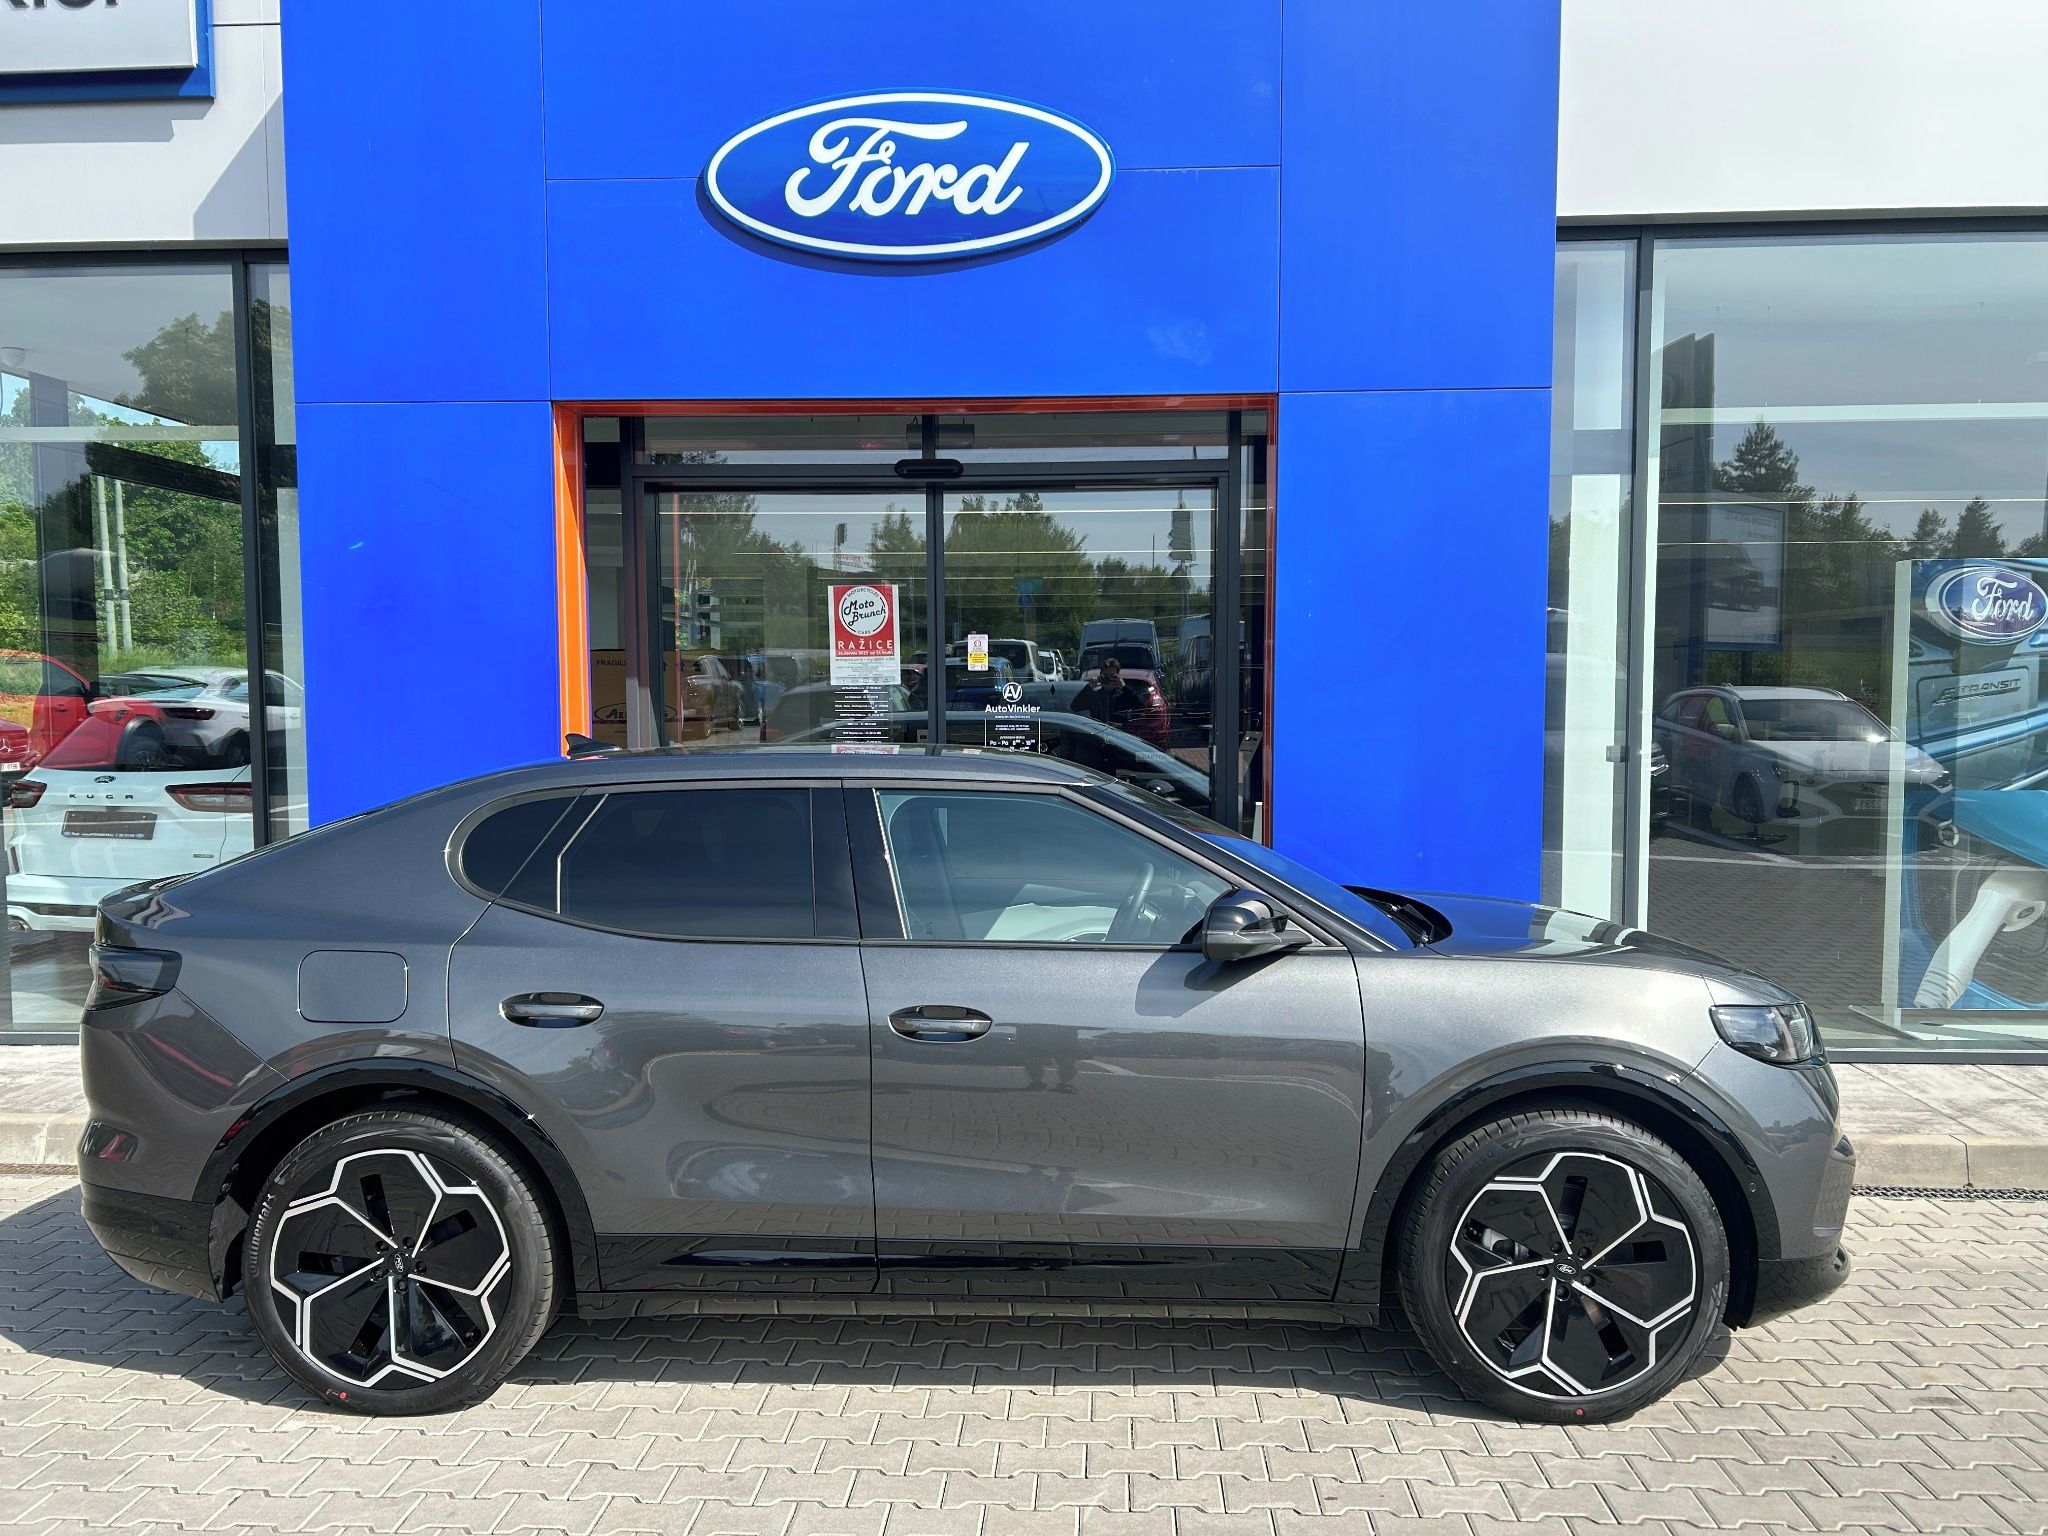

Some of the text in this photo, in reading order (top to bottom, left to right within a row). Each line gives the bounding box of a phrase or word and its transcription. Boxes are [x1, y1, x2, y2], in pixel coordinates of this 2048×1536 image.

[785, 117, 1030, 217] Ford
[1971, 576, 2034, 621] Ford
[843, 600, 875, 616] Moto
[848, 605, 887, 627] Brunch
[837, 639, 893, 650] RAŽICE
[596, 659, 627, 667] FRAGIL
[1003, 685, 1022, 700] AV
[985, 704, 1040, 713] AutoVinkler
[247, 1201, 273, 1276] Continental
